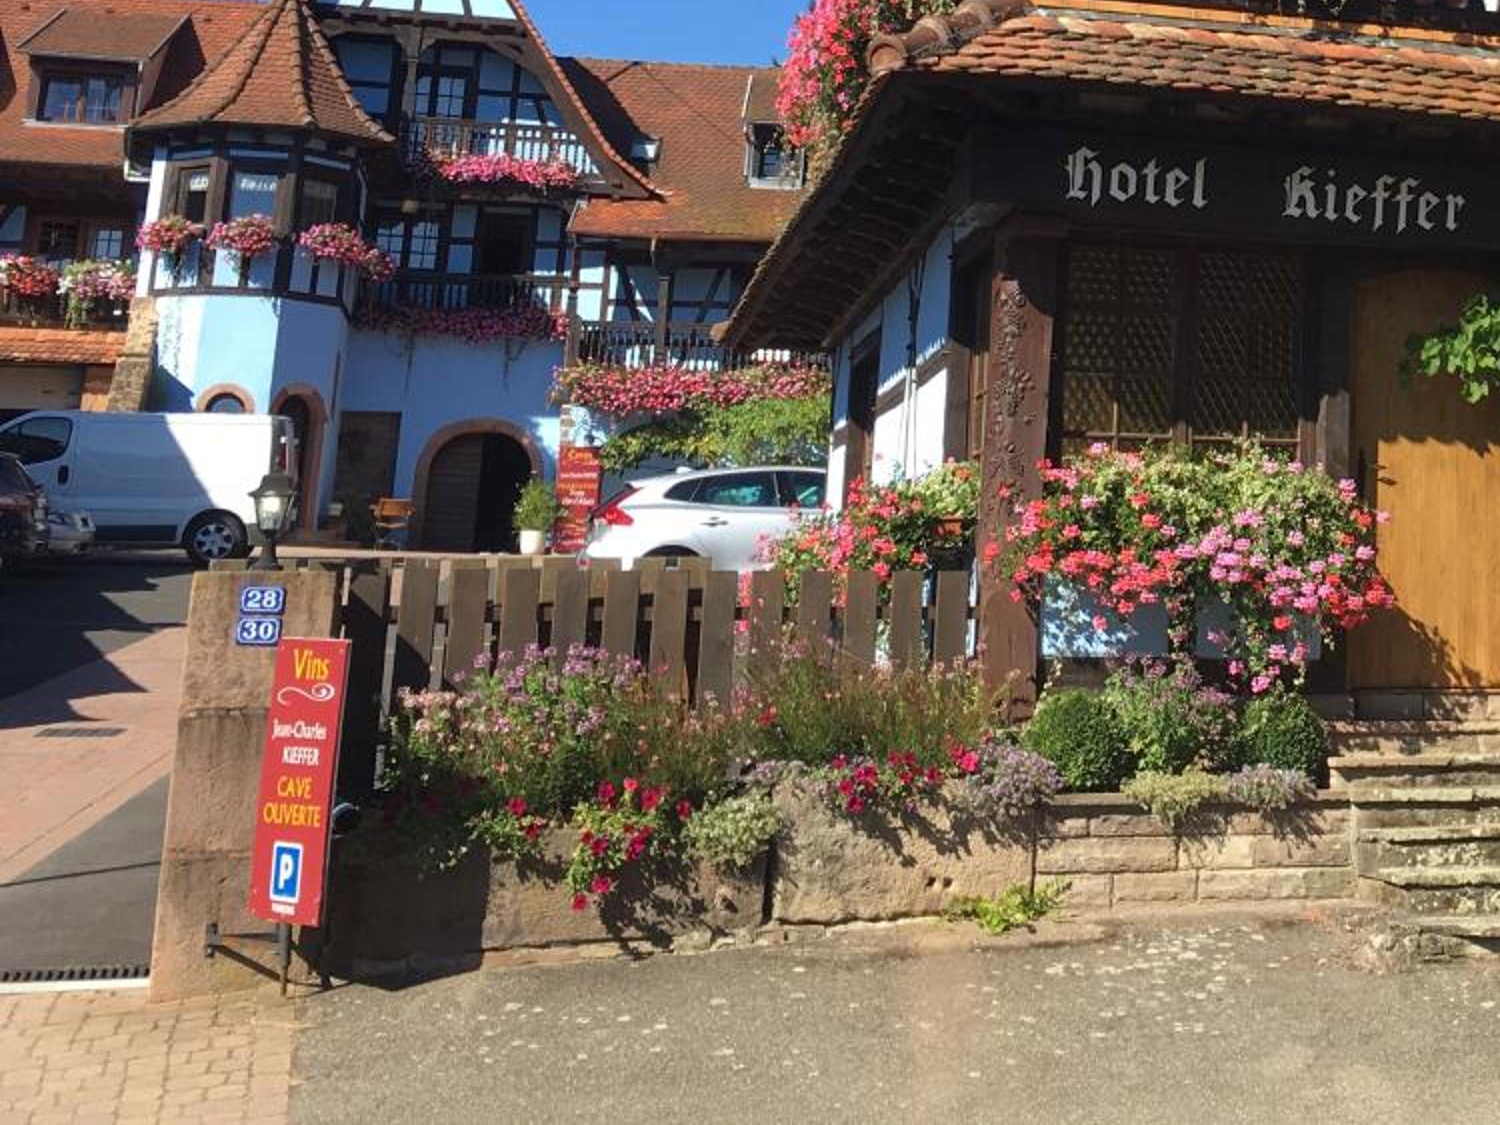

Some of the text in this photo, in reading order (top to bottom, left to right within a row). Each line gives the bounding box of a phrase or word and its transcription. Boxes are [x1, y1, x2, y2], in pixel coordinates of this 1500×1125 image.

[1064, 146, 1466, 234] Hotel Kieffer
[247, 590, 277, 608] 28
[242, 622, 273, 639] 30
[293, 648, 330, 681] Vins
[272, 718, 327, 741] Jean-Charles
[283, 746, 319, 767] KIEFFER
[277, 776, 313, 799] CAVE
[263, 801, 321, 828] OUVERTE
[278, 853, 294, 890] P
